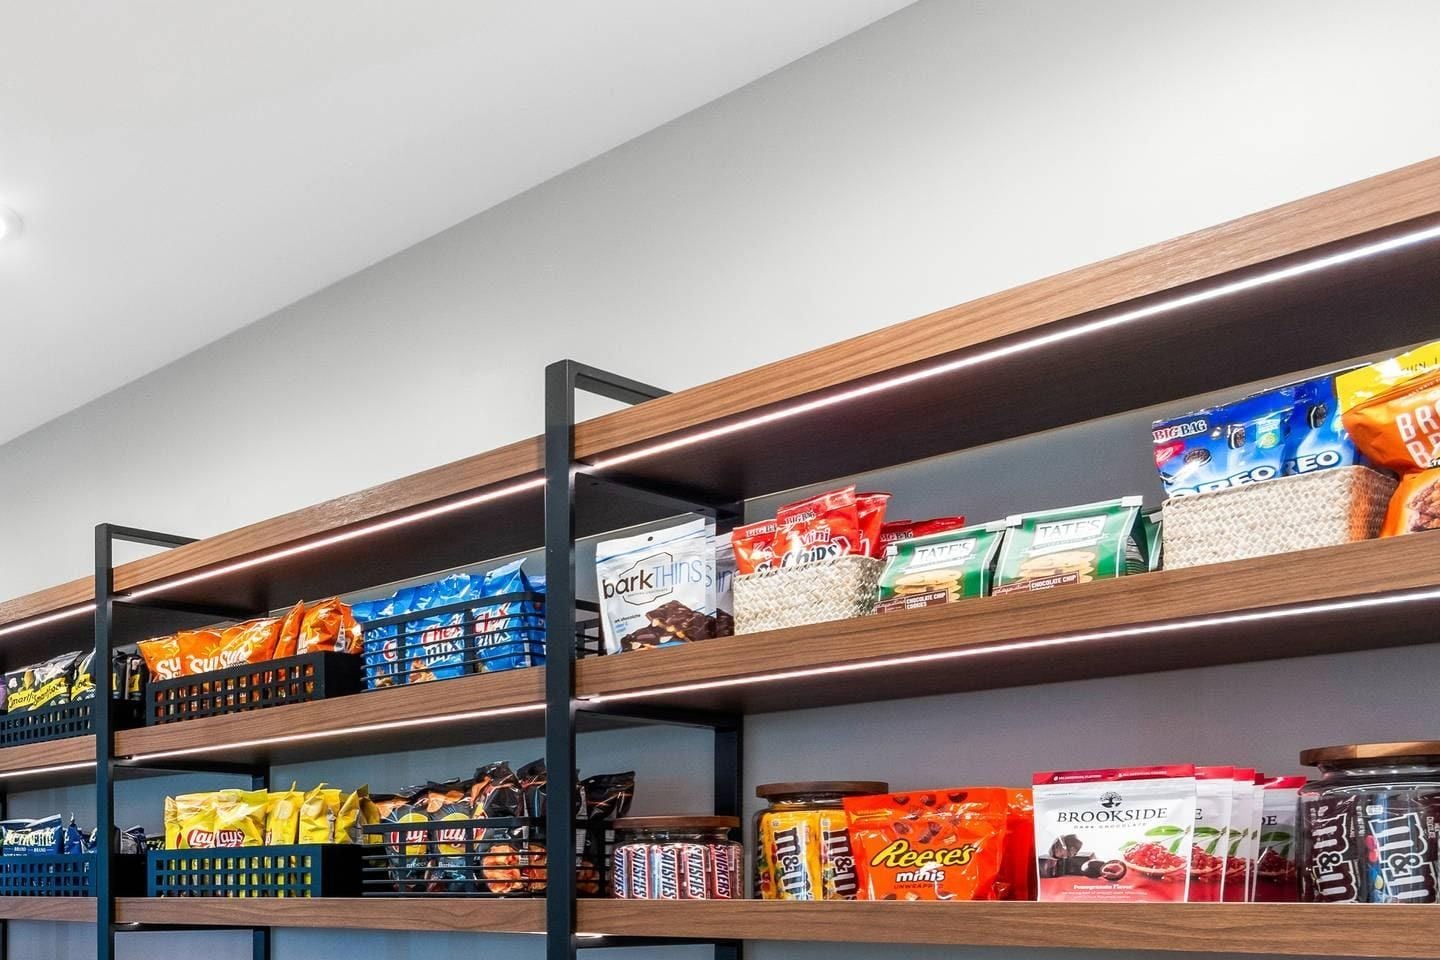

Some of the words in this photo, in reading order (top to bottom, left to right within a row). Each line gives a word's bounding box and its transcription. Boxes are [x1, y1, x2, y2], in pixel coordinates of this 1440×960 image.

[1154, 427, 1178, 441] BIG
[1180, 419, 1207, 435] BAG
[1039, 518, 1102, 539] TATE'S
[917, 540, 972, 561] TATE'S
[1057, 807, 1168, 823] BROOKSIDE
[189, 829, 215, 846] Lay
[215, 828, 244, 847] Lay's
[871, 838, 977, 867] Reese's
[632, 846, 647, 898] SATISFIES
[660, 846, 677, 899] SATISFIES
[687, 846, 705, 899] SATISFIES
[715, 844, 730, 898] SNICKERS
[896, 869, 945, 882] minis
